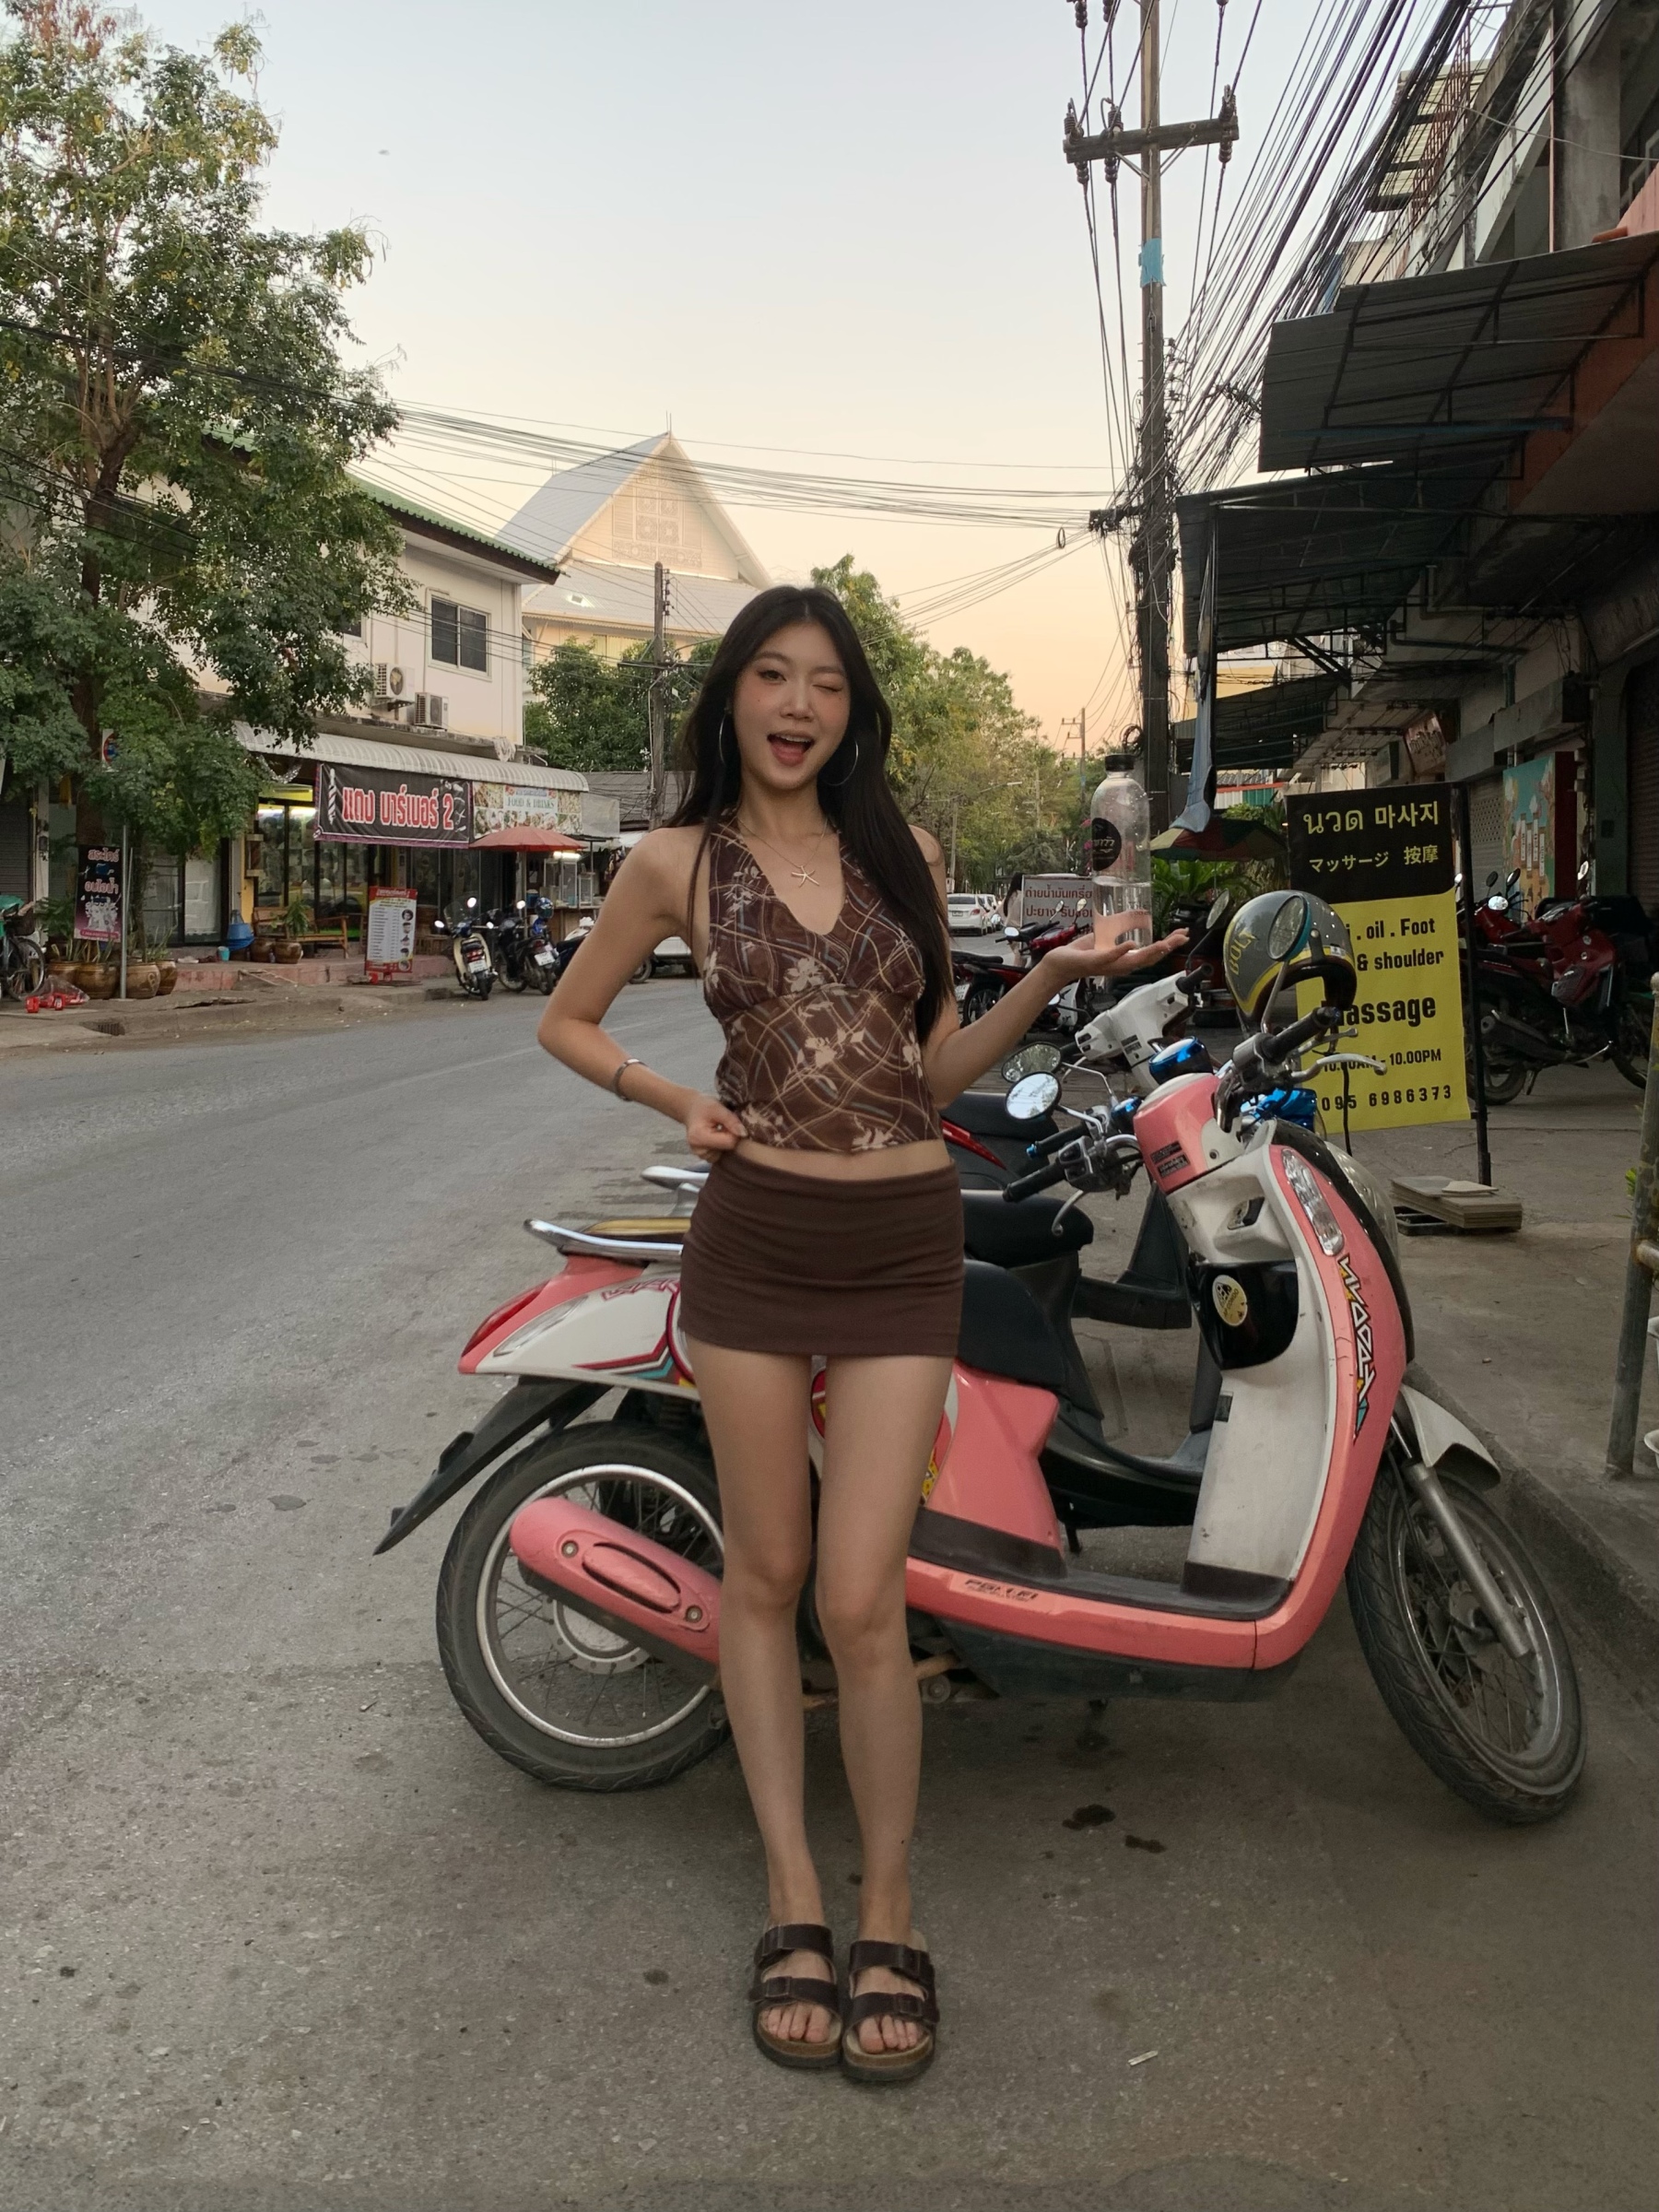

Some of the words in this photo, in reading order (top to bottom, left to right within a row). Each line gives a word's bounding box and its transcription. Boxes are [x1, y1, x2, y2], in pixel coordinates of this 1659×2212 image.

[380, 783, 439, 830] บาร์เบอร์
[442, 793, 454, 830] 2
[507, 796, 524, 807] FOOD
[533, 798, 555, 809] DRINKS
[1302, 809, 1364, 835] นวด
[1374, 800, 1439, 830] 마사지
[1309, 851, 1389, 873] マッサージ
[1403, 843, 1439, 865] 按摩
[1025, 883, 1093, 899] ถ่ายน้ำมันเครื่อ
[1366, 920, 1385, 939] oil
[1400, 918, 1436, 936] Foot
[1357, 953, 1369, 971] &
[1374, 947, 1444, 971] shoulder
[1389, 1048, 1441, 1066] 10.00PM
[1321, 1094, 1358, 1112] 095
[1369, 1084, 1452, 1107] 6986373
